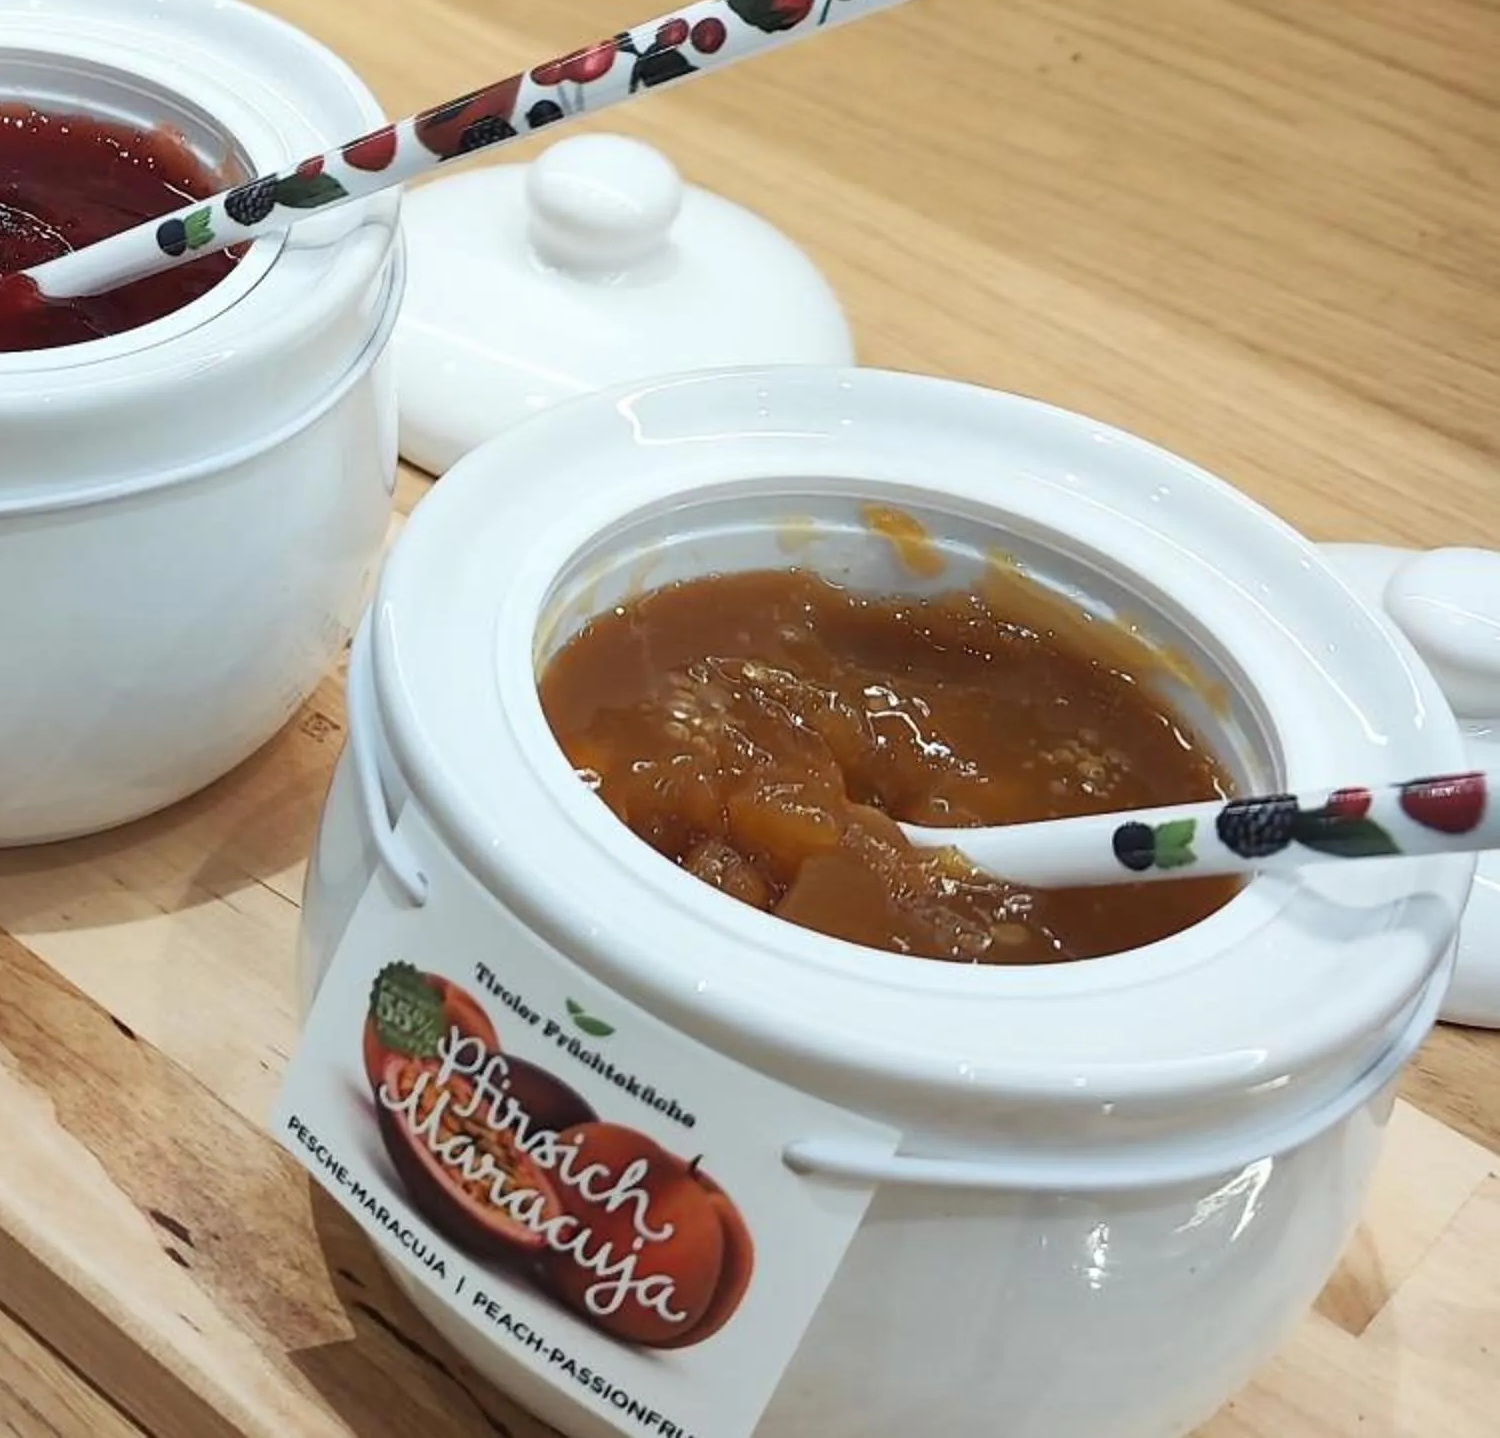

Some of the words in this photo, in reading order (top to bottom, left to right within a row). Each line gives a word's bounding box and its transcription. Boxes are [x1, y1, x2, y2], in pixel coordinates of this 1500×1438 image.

[437, 1024, 675, 1242] Pfirsich
[473, 961, 541, 1027] Tiroler
[543, 1015, 698, 1129] Früchteküche
[286, 1114, 447, 1281] PESCHE-MARACUJA
[379, 1067, 689, 1324] Maracuja
